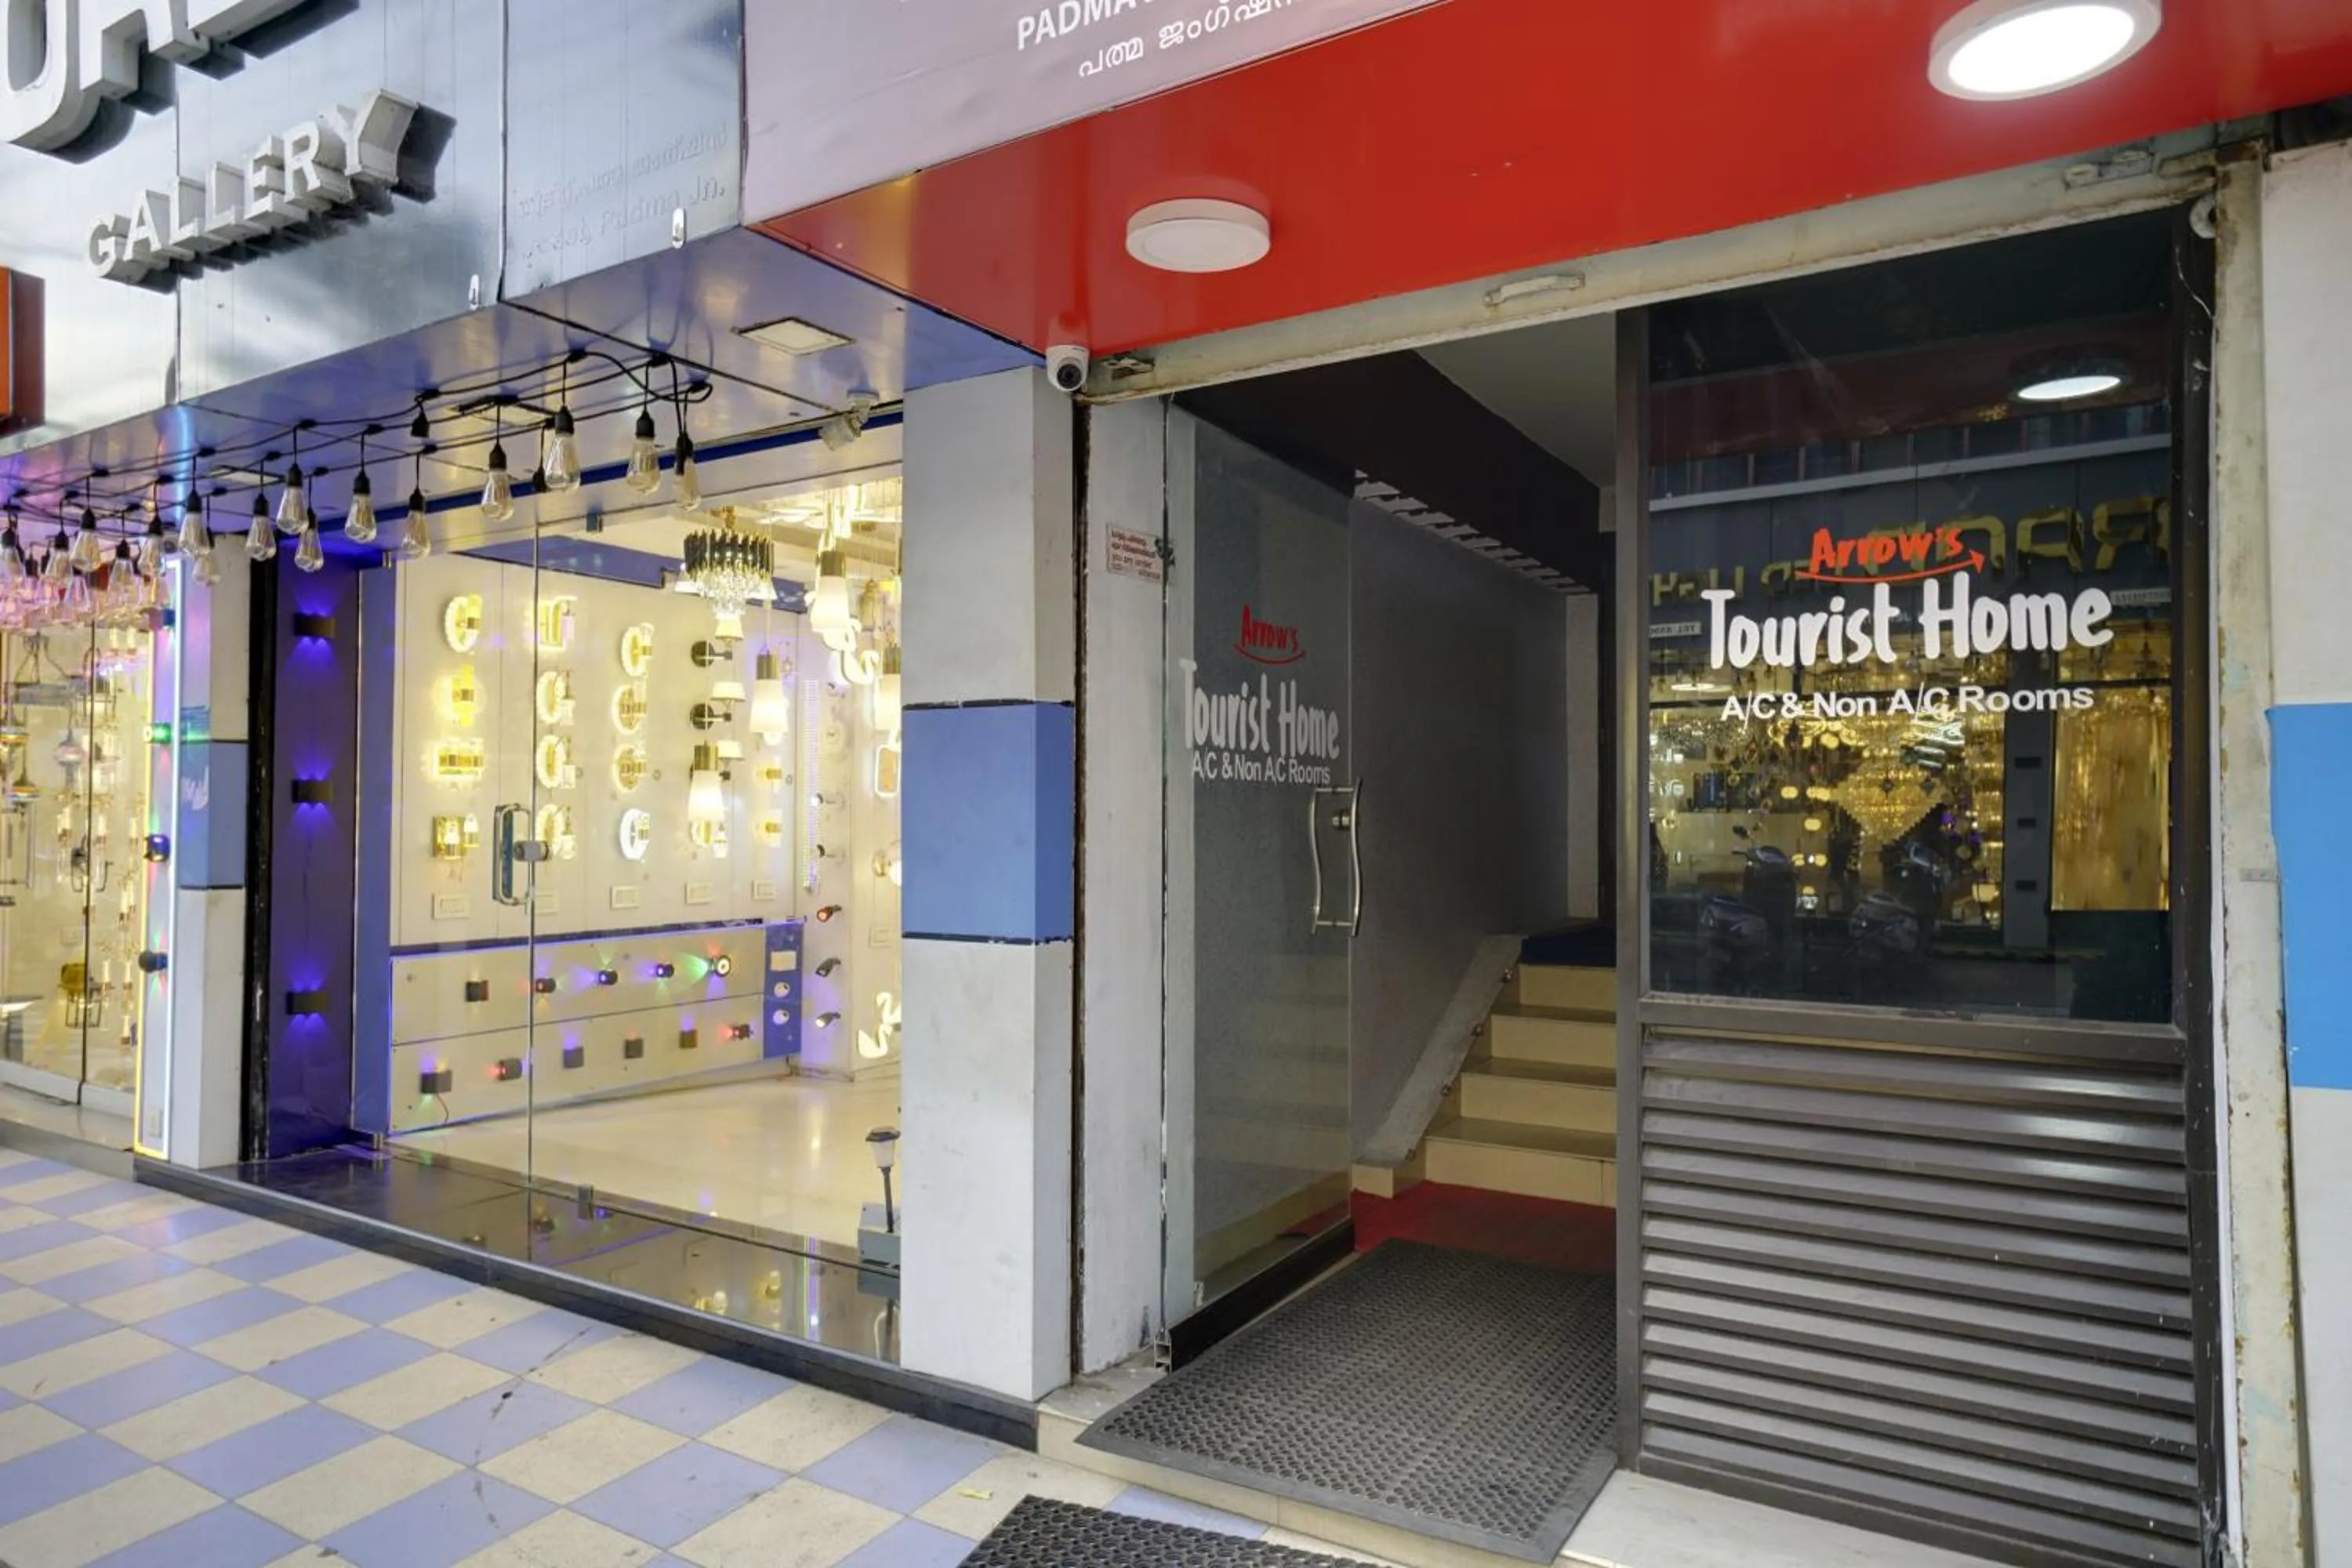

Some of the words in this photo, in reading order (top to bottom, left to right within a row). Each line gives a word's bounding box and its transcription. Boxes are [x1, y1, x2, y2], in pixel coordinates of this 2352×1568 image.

[88, 88, 416, 281] GALLERY
[1809, 527, 1963, 573] Arrow's
[1700, 582, 1897, 670] Tourist
[1918, 571, 2114, 659] Home
[1179, 658, 1271, 753] Tourist
[1278, 679, 1341, 759] Home
[1721, 689, 1777, 732] A/C
[1813, 691, 1877, 718] Non
[1887, 681, 1950, 720] A/C
[1958, 685, 2096, 713] Rooms
[1235, 753, 1261, 782] Non
[1288, 758, 1330, 785] Rooms
